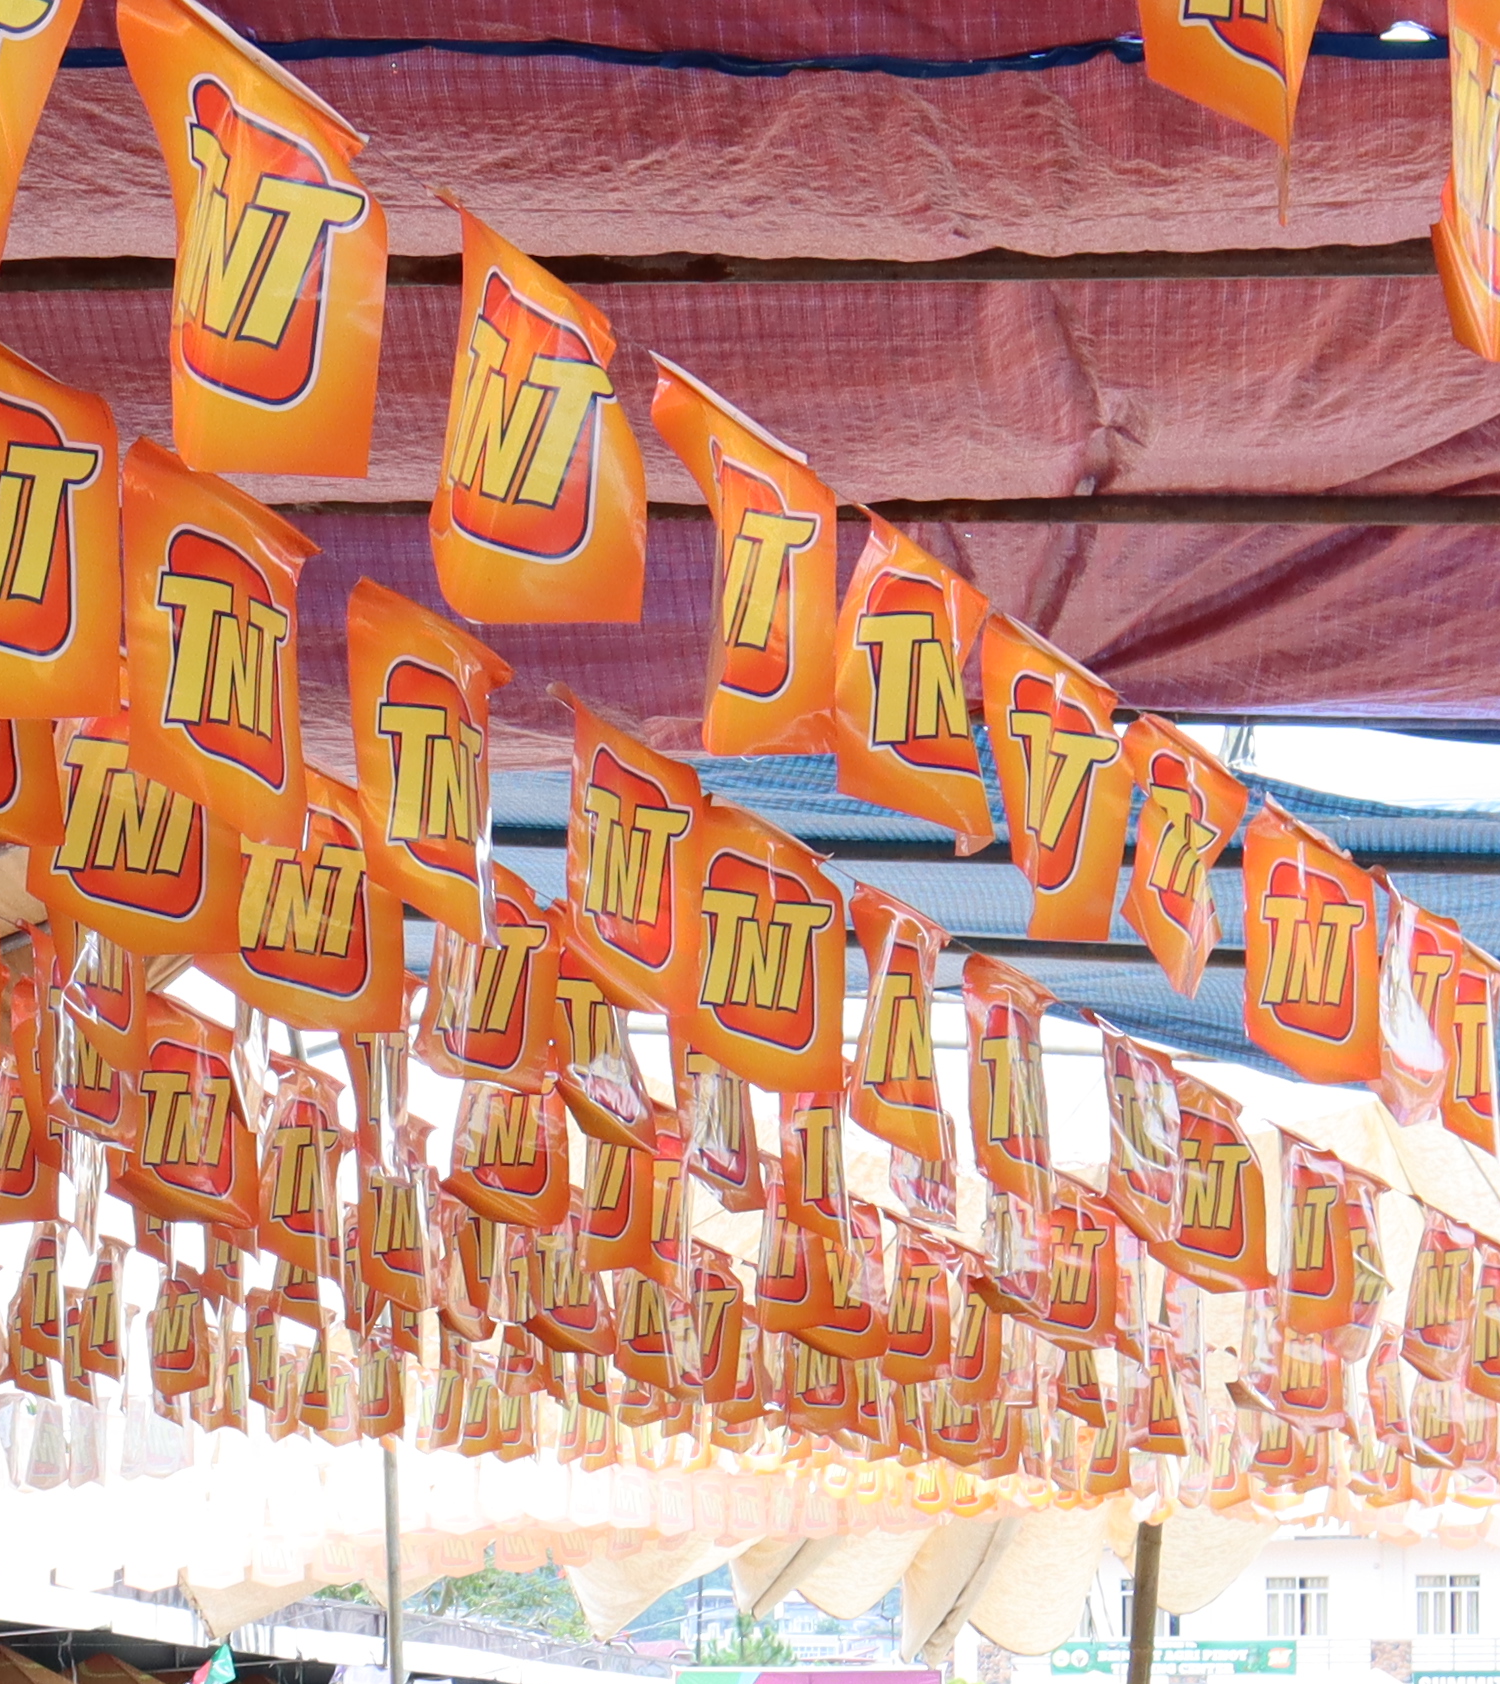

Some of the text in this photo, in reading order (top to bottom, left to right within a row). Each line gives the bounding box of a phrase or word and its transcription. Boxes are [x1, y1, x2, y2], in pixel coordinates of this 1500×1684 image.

[158, 574, 288, 739] TNT
[238, 840, 367, 957] TNT
[582, 790, 692, 930] TNT
[700, 887, 837, 1014] TNT
[1260, 894, 1364, 1007] TNT
